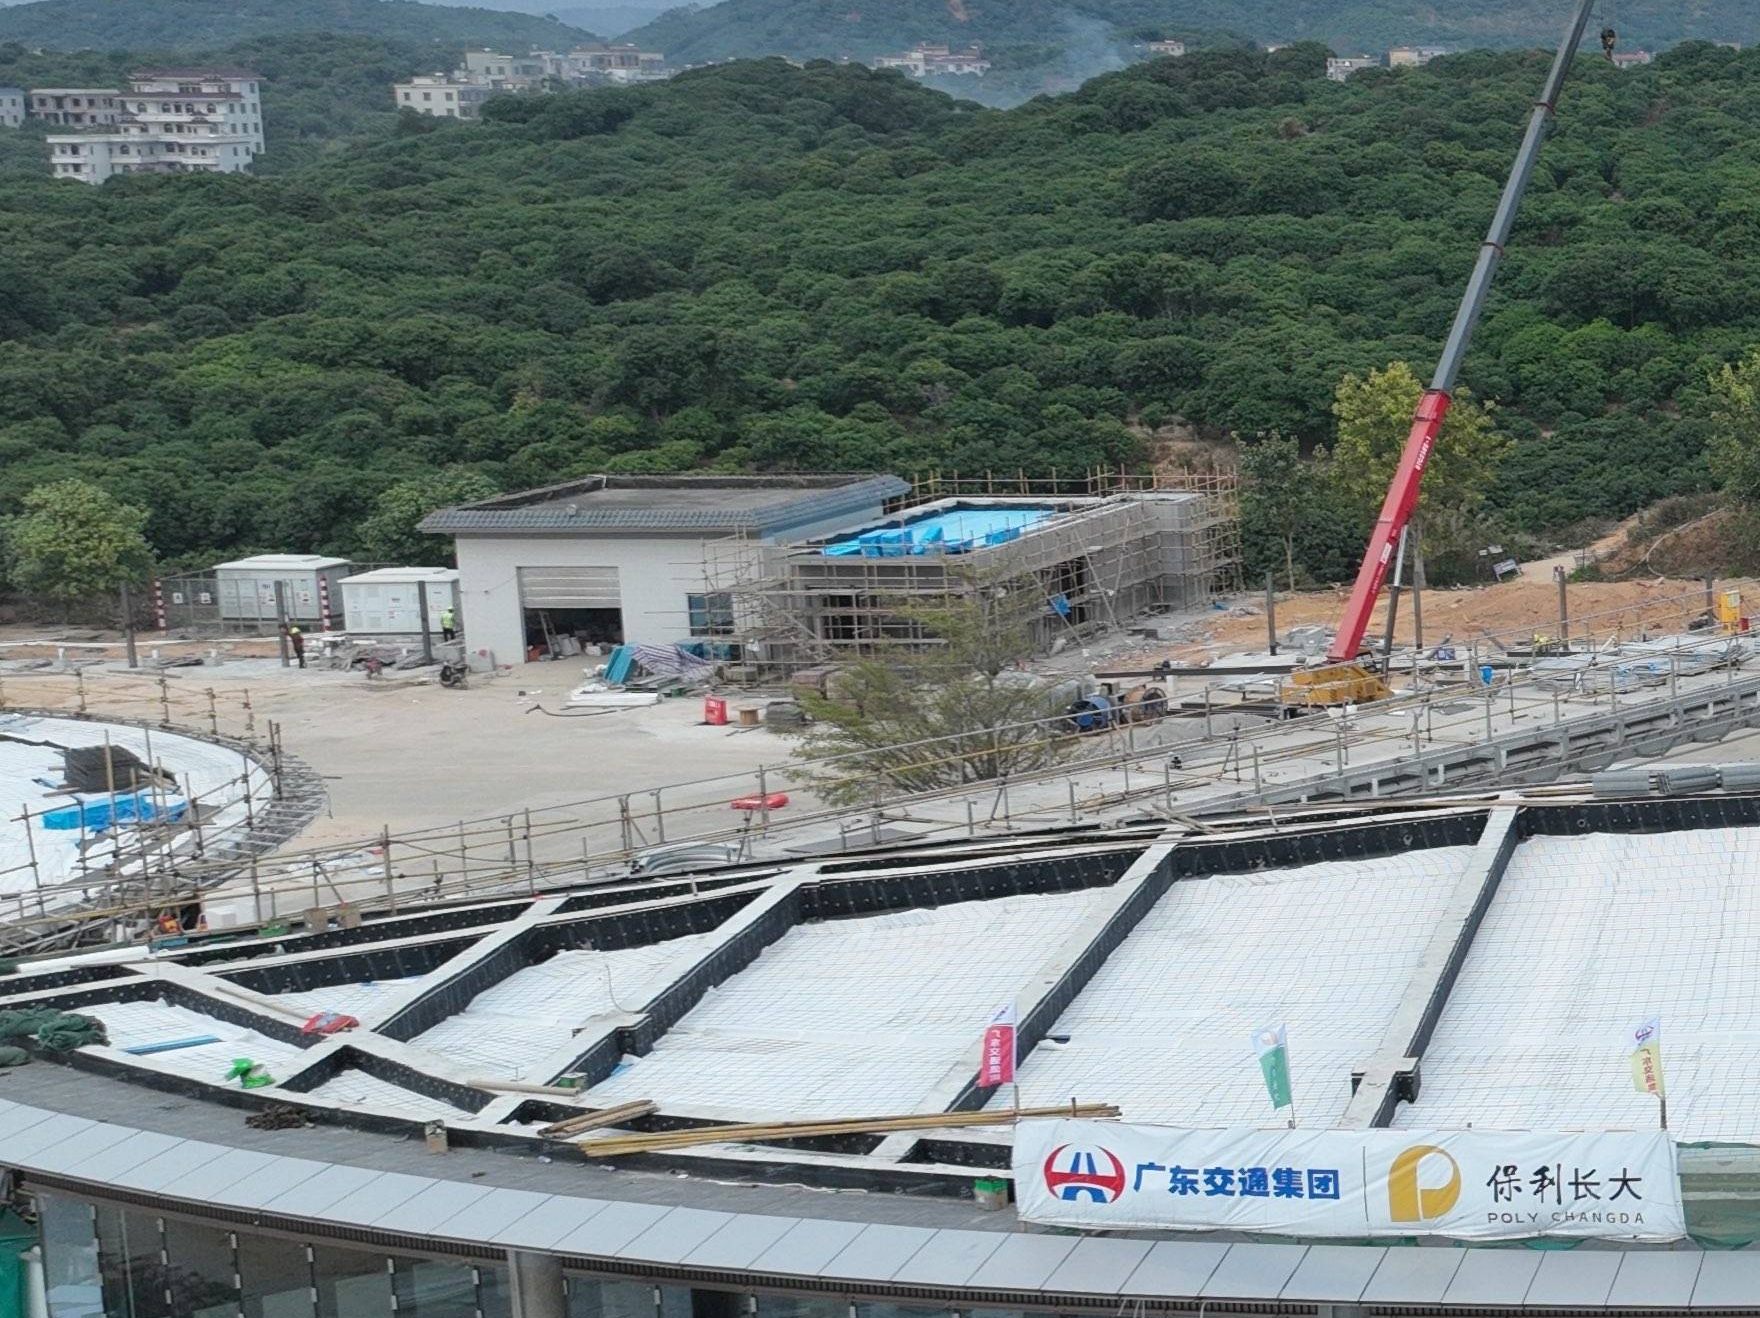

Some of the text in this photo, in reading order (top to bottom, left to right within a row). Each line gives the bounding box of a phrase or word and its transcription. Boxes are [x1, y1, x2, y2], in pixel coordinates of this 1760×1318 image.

[1133, 1162, 1340, 1200] 广东交通集团
[1486, 1163, 1643, 1205] 保利长大
[1487, 1210, 1645, 1225] POLY CHANGDA
